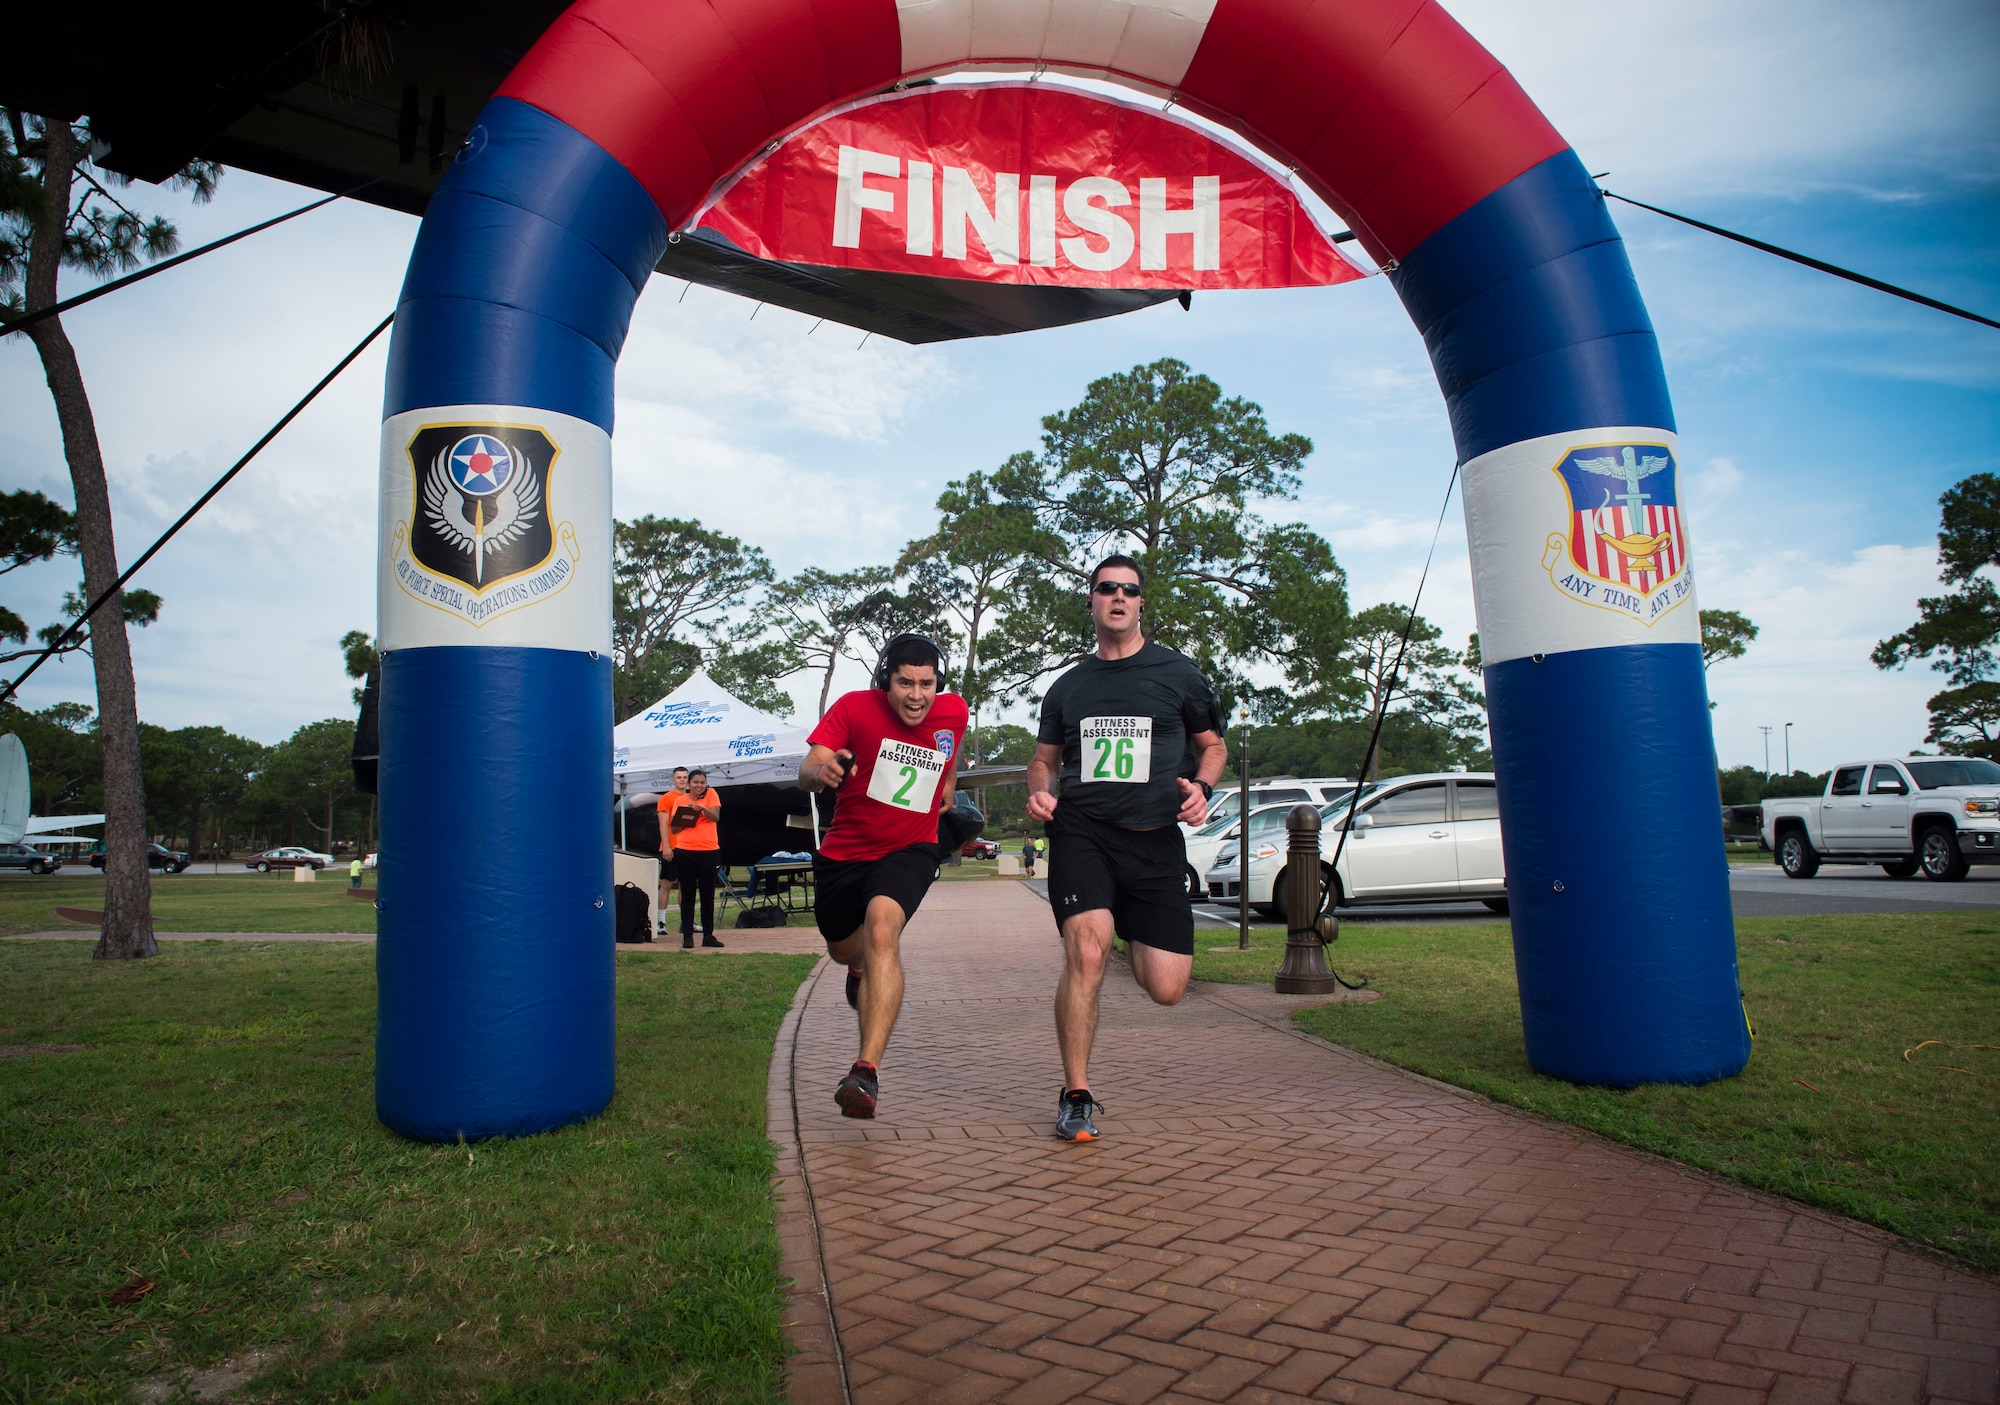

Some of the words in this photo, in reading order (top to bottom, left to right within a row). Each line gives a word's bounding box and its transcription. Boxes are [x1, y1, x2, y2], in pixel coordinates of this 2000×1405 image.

[832, 144, 1221, 273] FINISH
[397, 559, 407, 579] AIR
[405, 570, 432, 596] FORCE
[430, 582, 463, 611] SPECIAL
[466, 584, 529, 620] OPERATIONS
[529, 558, 570, 596] COMMAND
[1560, 573, 1596, 598] ANY
[1603, 588, 1641, 614] TIME
[1650, 589, 1671, 618] ANY
[644, 710, 703, 721] Fitness
[654, 720, 668, 729] &
[670, 716, 723, 727] Sports
[1094, 718, 1136, 728] FITNESS
[1082, 728, 1150, 739] ASSESSMENT
[728, 740, 761, 749] Fitness
[735, 749, 743, 757] &
[744, 745, 774, 757] Sports
[895, 743, 934, 761] FITNESS
[880, 749, 943, 773] ASSESSMENT
[1093, 737, 1134, 779] 26
[891, 765, 917, 807] 2
